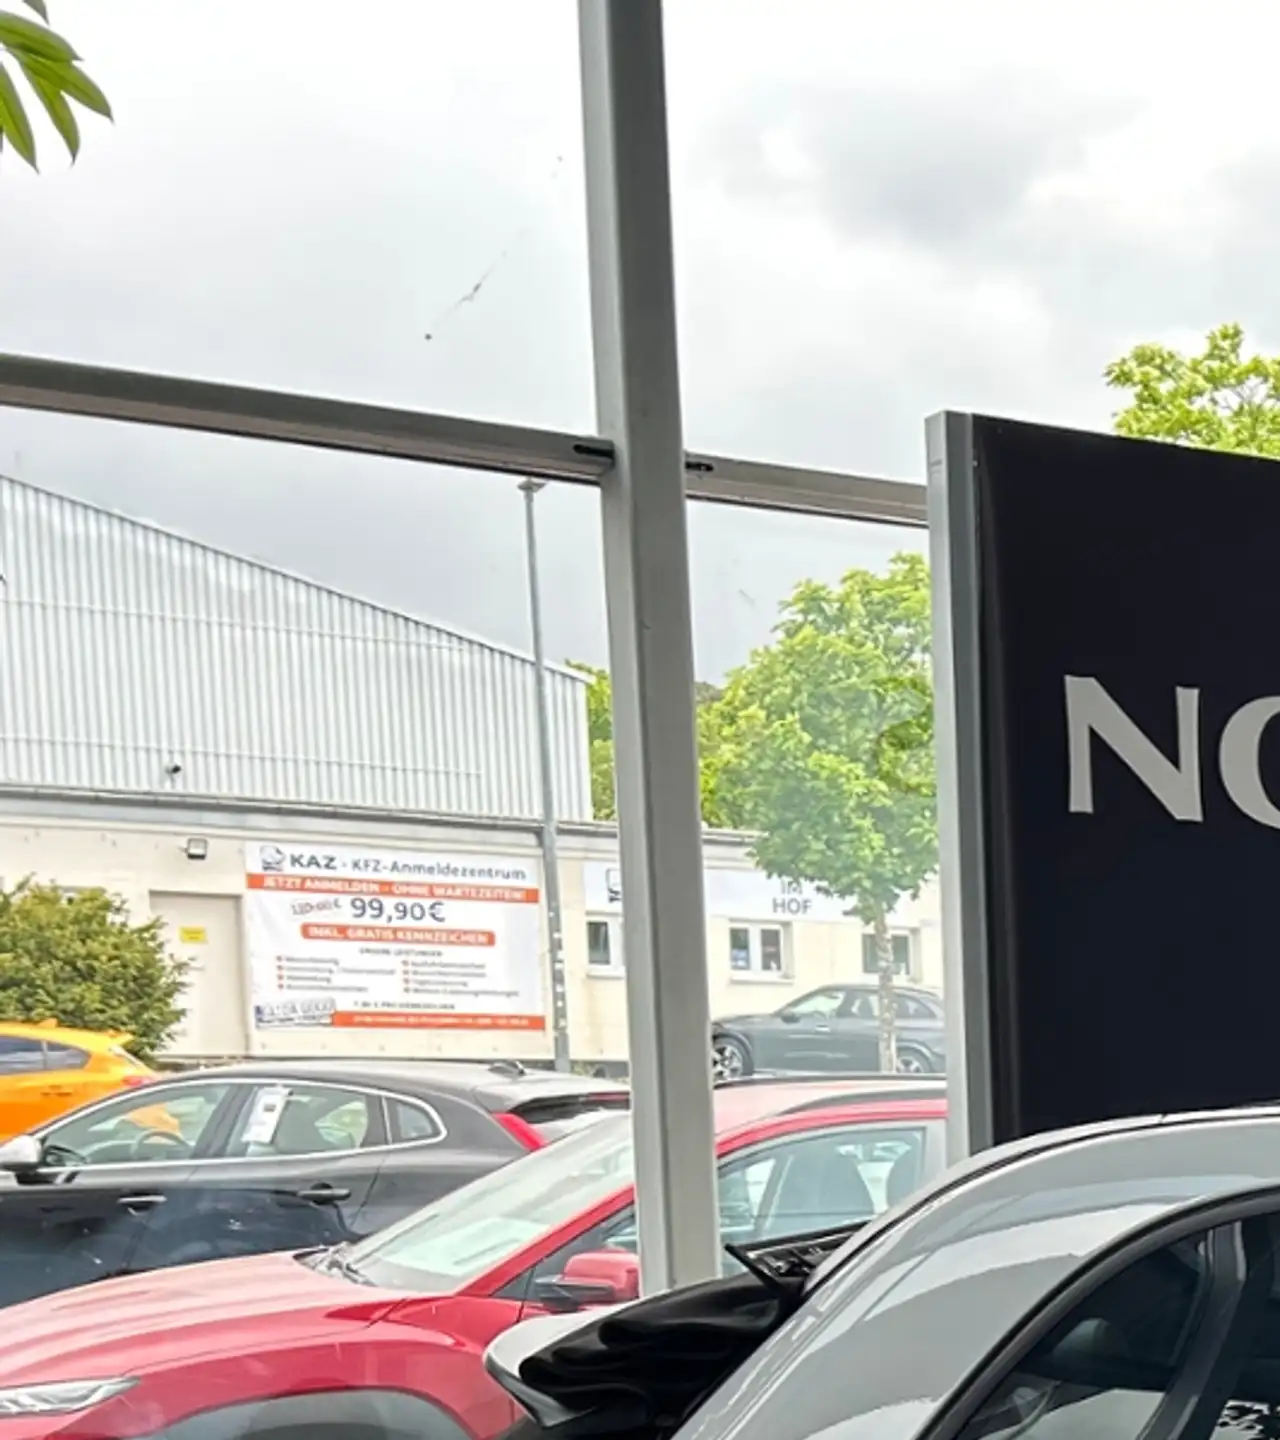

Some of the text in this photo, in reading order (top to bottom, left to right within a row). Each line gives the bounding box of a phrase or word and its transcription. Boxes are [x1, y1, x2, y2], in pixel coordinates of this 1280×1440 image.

[289, 853, 337, 870] KAZ
[351, 857, 527, 880] KFZ-Anmeldezentrum
[263, 876, 301, 890] JETZT
[303, 876, 381, 893] ANMELDEN
[392, 882, 430, 897] OHNE
[350, 896, 446, 923] 99,90€
[772, 896, 813, 915] HOF
[309, 925, 489, 945] INKL. GRATIS KENNZEICHEN
